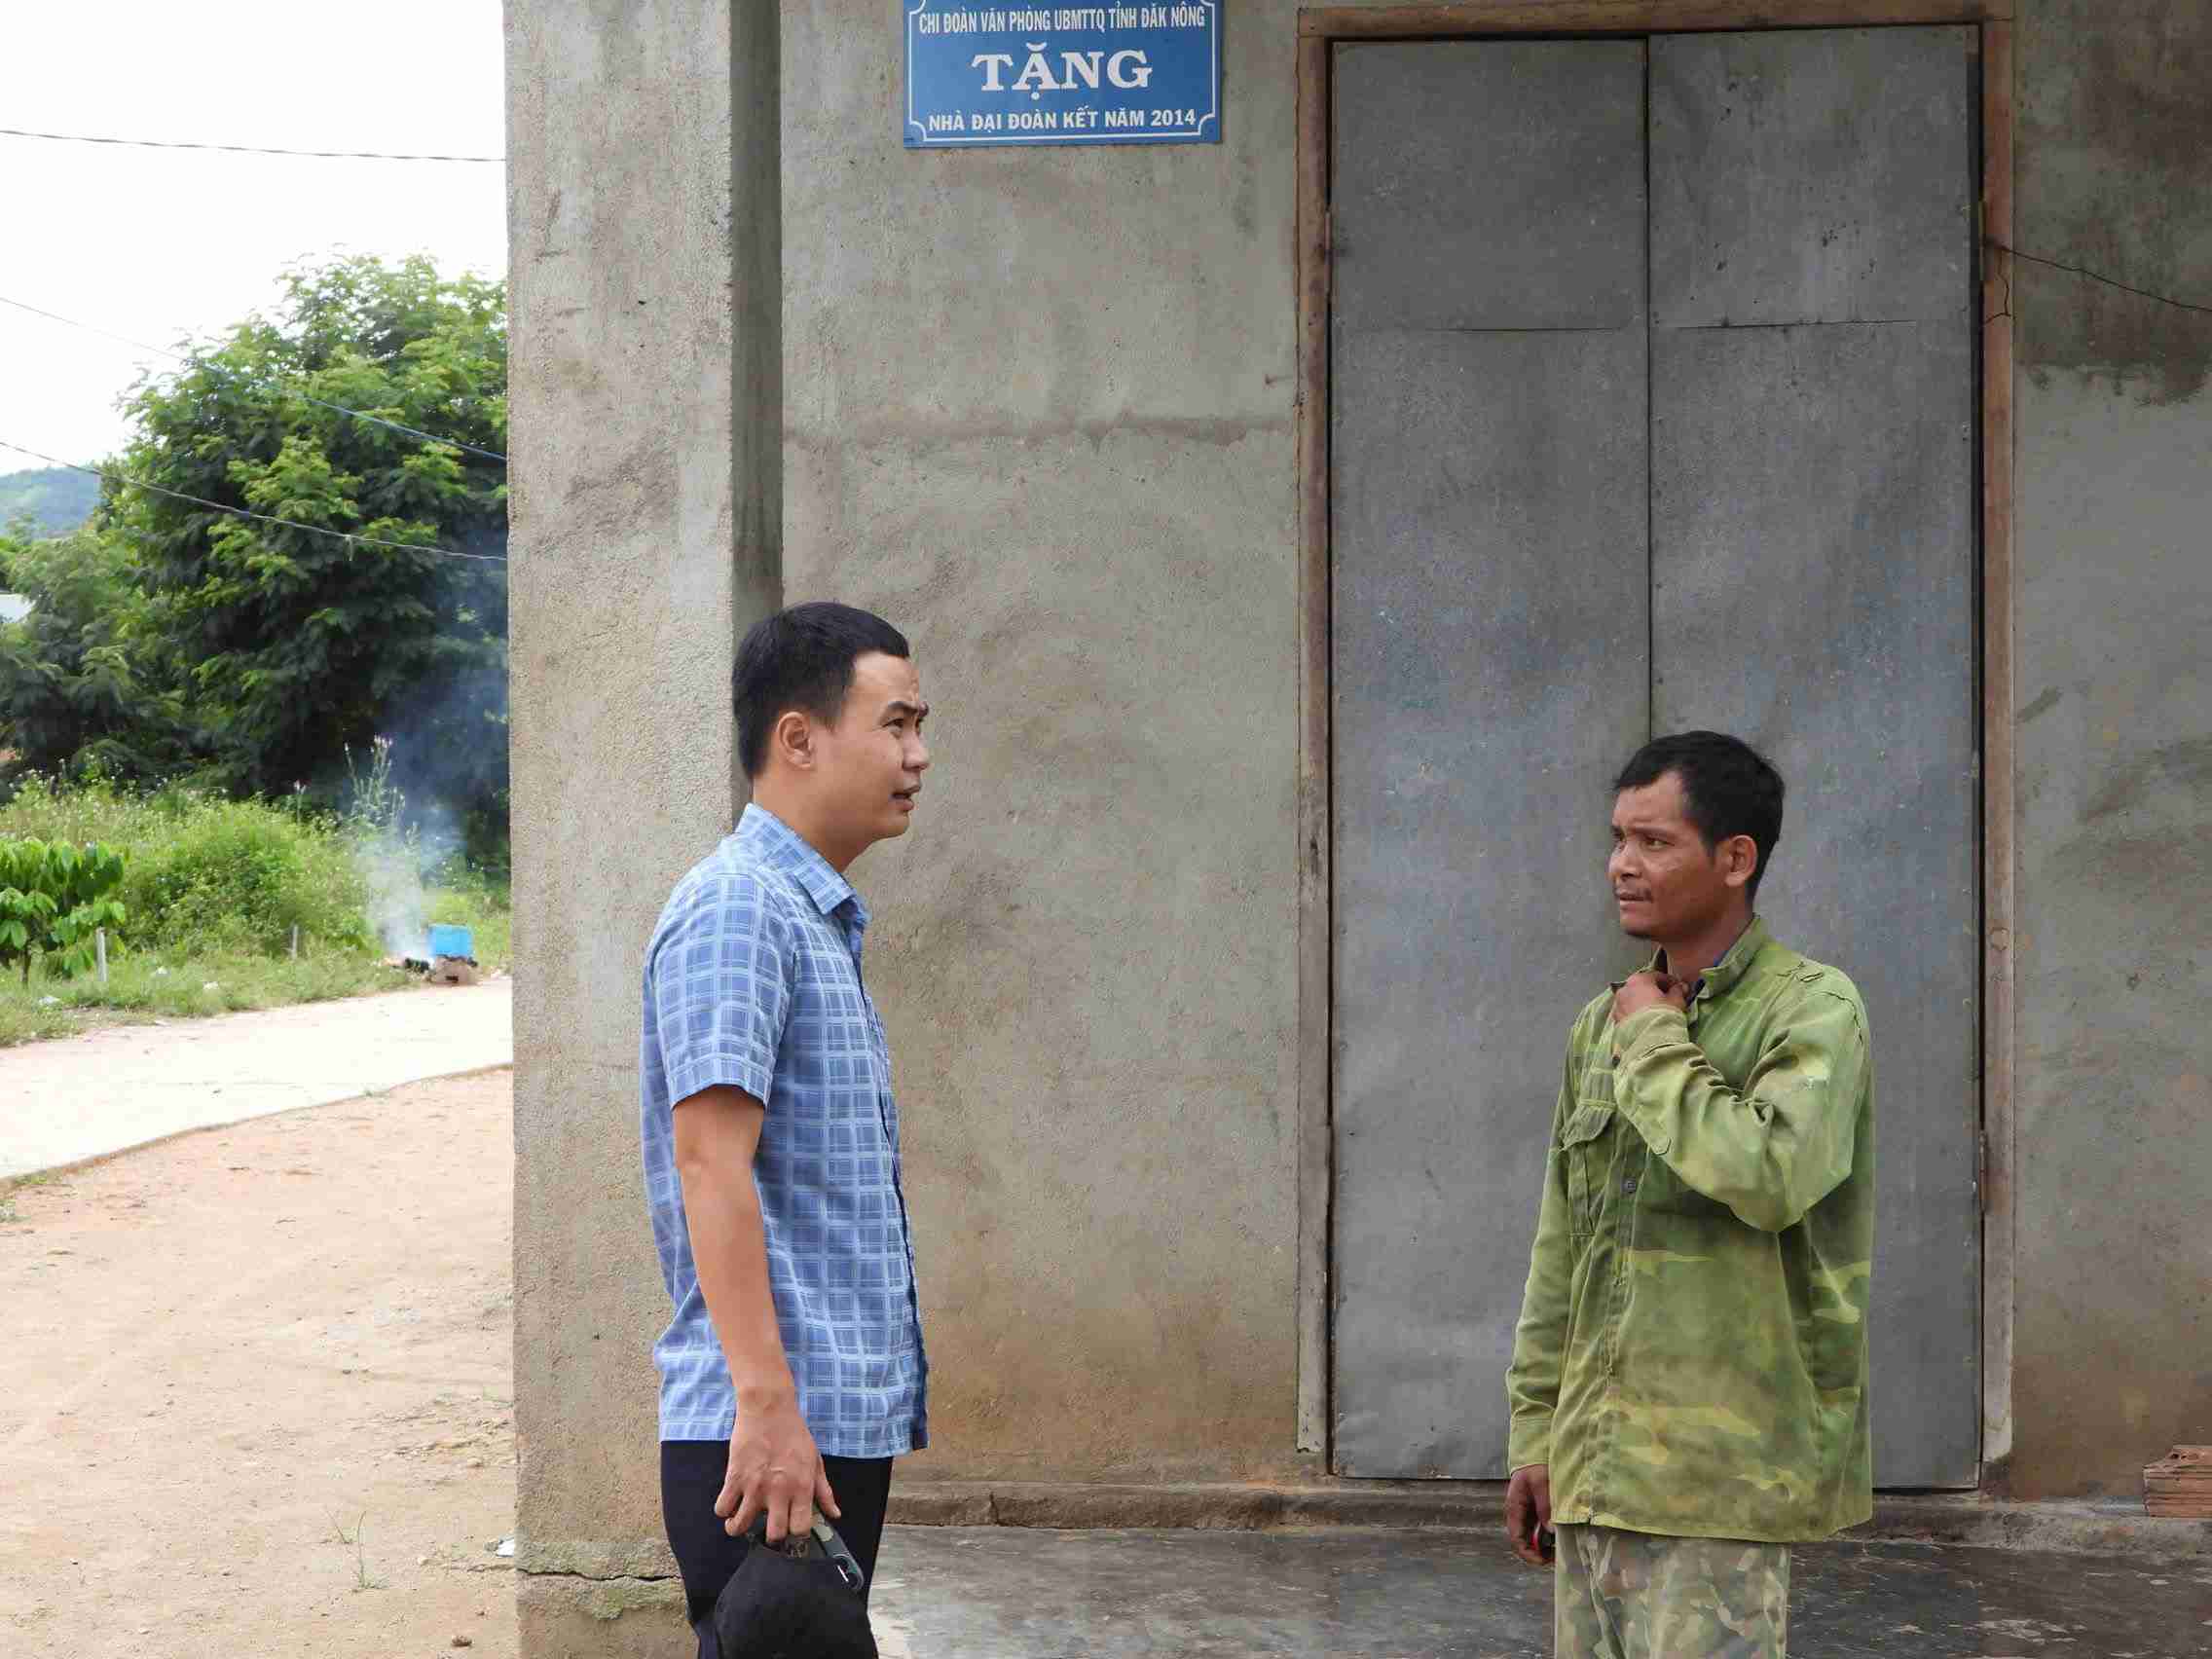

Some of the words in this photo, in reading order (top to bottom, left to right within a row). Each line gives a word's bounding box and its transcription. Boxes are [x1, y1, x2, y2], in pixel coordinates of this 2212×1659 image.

[919, 13, 940, 33] CHI
[943, 6, 977, 32] ĐOÀN
[1009, 6, 1051, 31] PHÒNG
[1054, 8, 1105, 32] UBMTTQ
[1108, 1, 1137, 29] TỈNH
[1171, 1, 1205, 27] NÔNG
[972, 42, 1153, 100] TẶNG
[929, 110, 965, 130] NHÀ
[972, 114, 1002, 133] ĐẠI
[1008, 109, 1057, 129] ĐOÀN
[1063, 105, 1098, 128] KẾT
[1105, 107, 1144, 127] NĂM
[1151, 109, 1196, 127] 2014
